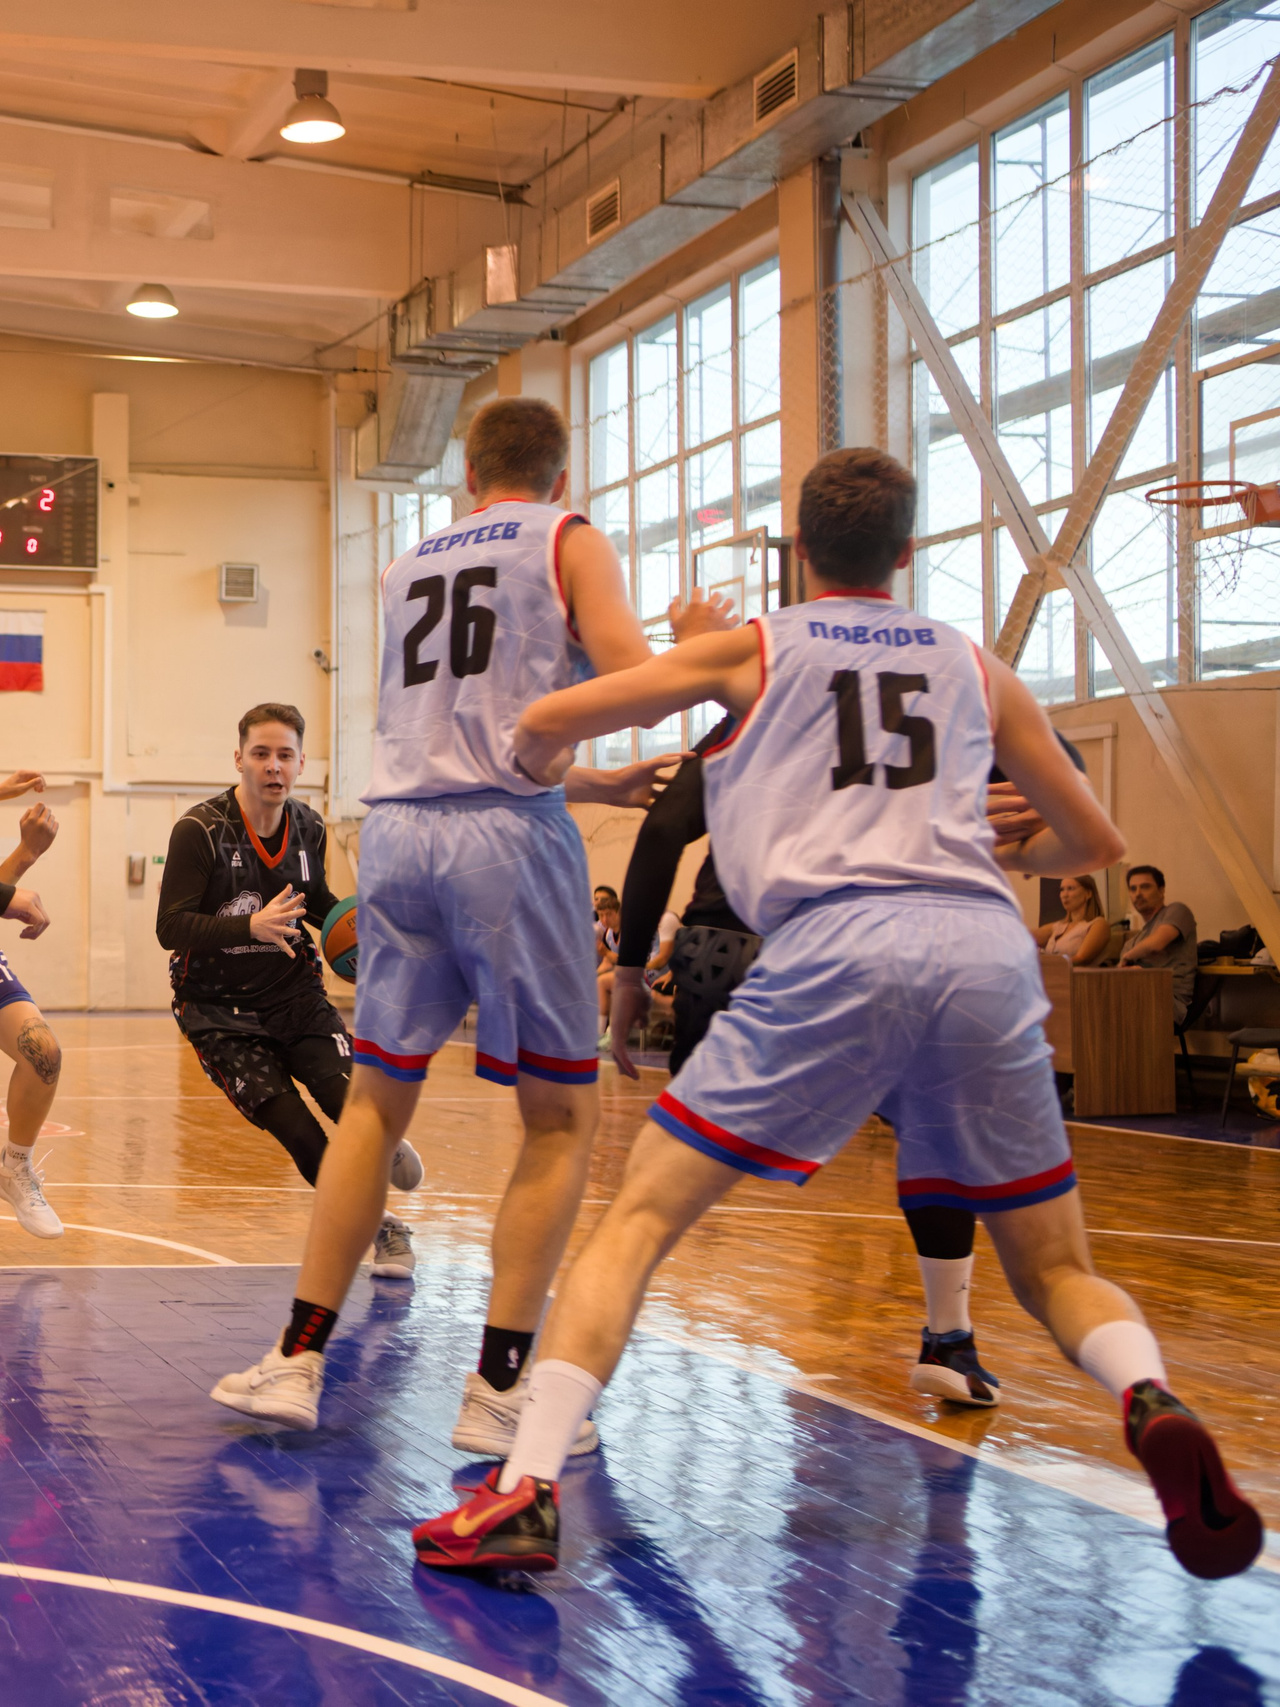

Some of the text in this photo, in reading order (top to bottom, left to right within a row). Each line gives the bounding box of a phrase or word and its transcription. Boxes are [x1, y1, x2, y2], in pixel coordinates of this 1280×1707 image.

[39, 489, 55, 511] 2
[26, 538, 38, 553] 0
[416, 521, 524, 557] СЕРГЕЕВ
[403, 566, 498, 689] 26
[808, 620, 938, 647] ПАВЛОВ
[827, 669, 937, 792] 15
[299, 850, 310, 881] 11
